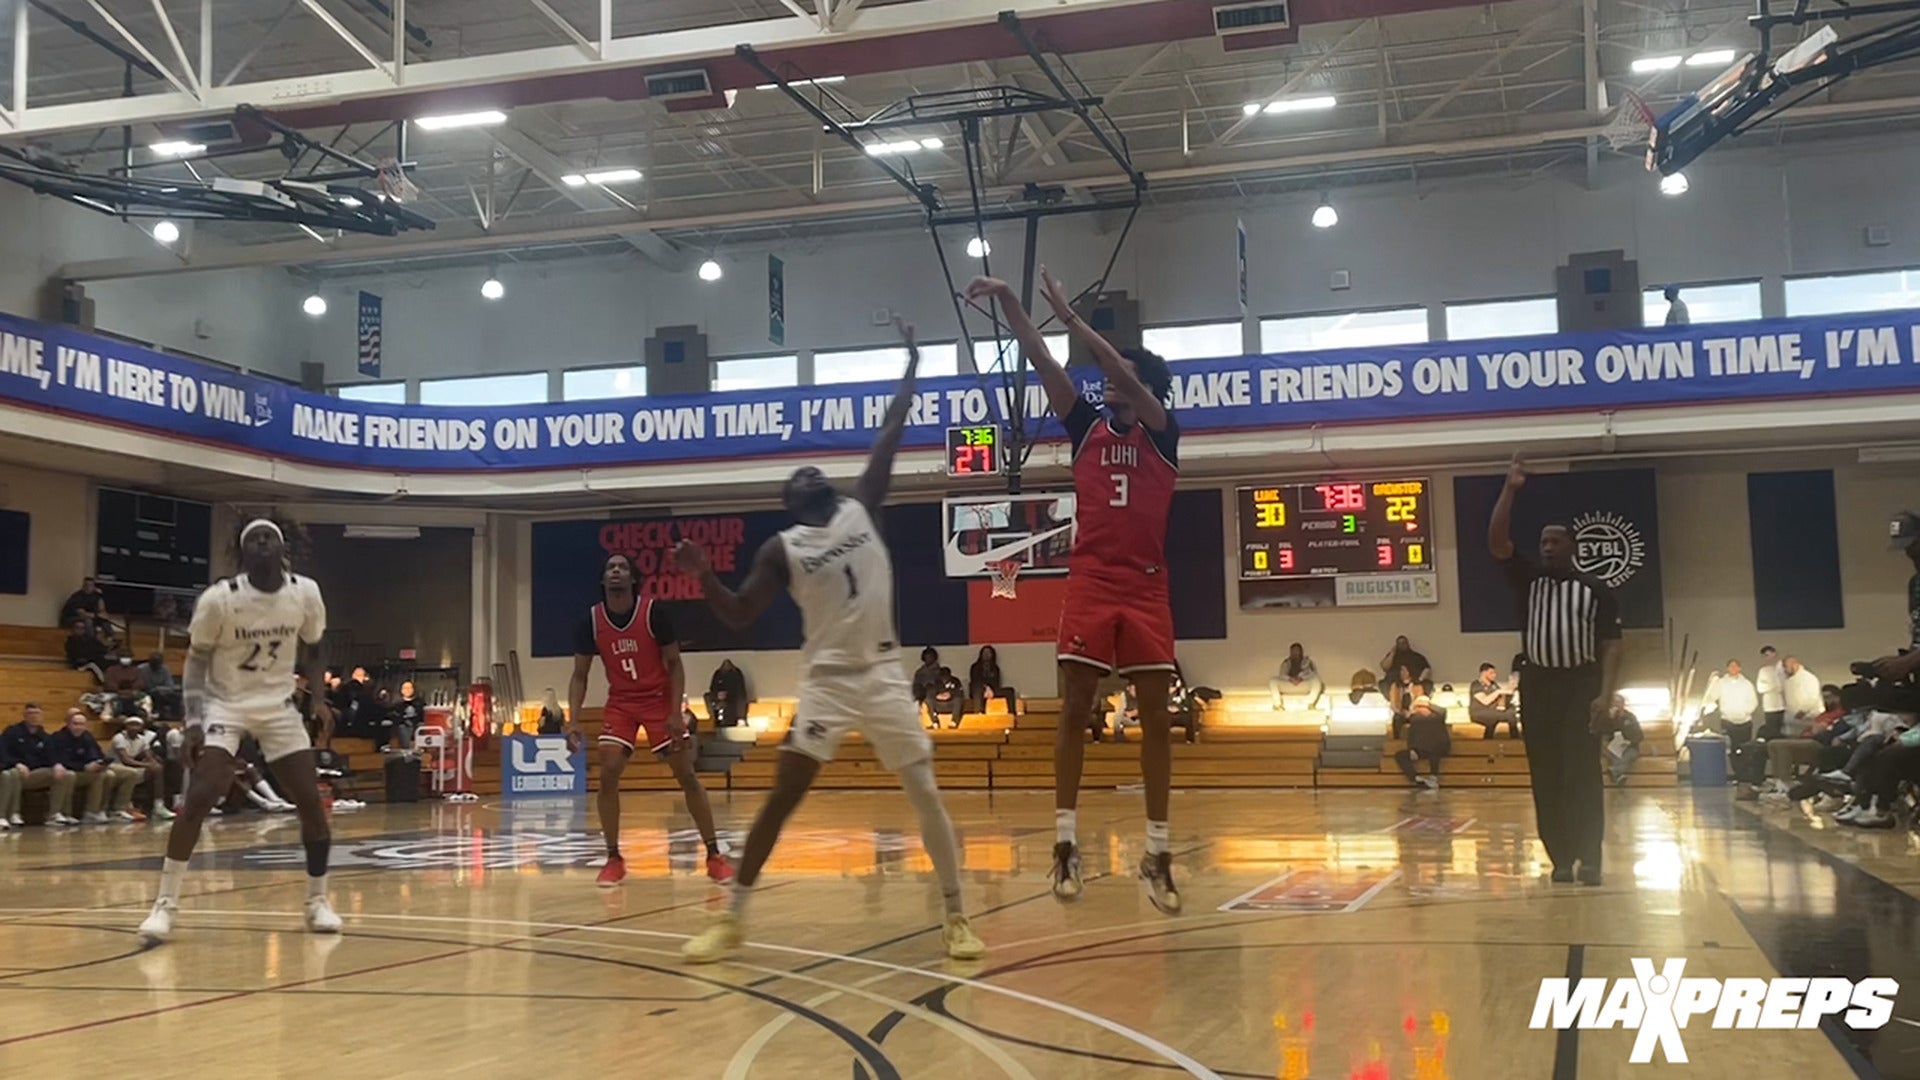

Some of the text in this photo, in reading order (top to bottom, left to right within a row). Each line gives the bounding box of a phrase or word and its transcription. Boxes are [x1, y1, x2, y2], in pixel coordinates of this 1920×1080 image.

[1164, 327, 1900, 410] MAKE FRIENDS ON YOUR OWN TIME, I'M
[57, 346, 102, 393] I'M
[107, 358, 165, 407] HERE
[169, 373, 198, 414] TO
[202, 380, 252, 426] WIN.
[292, 403, 359, 446] MAKE
[364, 416, 486, 452] FRIENDS
[493, 417, 537, 450] ON
[545, 413, 625, 448] YOUR
[632, 406, 704, 441] OWN
[711, 402, 793, 441] TIME,
[802, 398, 854, 433] I'M
[946, 388, 988, 423] TO
[961, 429, 993, 446] 7:36
[955, 446, 991, 473] 27
[1100, 444, 1138, 468] LUHI
[1109, 473, 1129, 507] 3
[1256, 503, 1285, 527] 30
[1386, 496, 1416, 521] 22
[599, 517, 745, 551] CHECK YOUR
[1342, 515, 1356, 533] 3
[1254, 551, 1268, 570] 0
[1279, 550, 1294, 569] 3
[1377, 545, 1393, 566] 3
[1407, 544, 1423, 564] 0
[1578, 541, 1623, 558] EYBL
[843, 563, 859, 599] 1
[1346, 580, 1411, 595] AUGUSTA
[237, 640, 282, 672] 23
[611, 638, 638, 656] LUHI
[620, 657, 638, 681] 4
